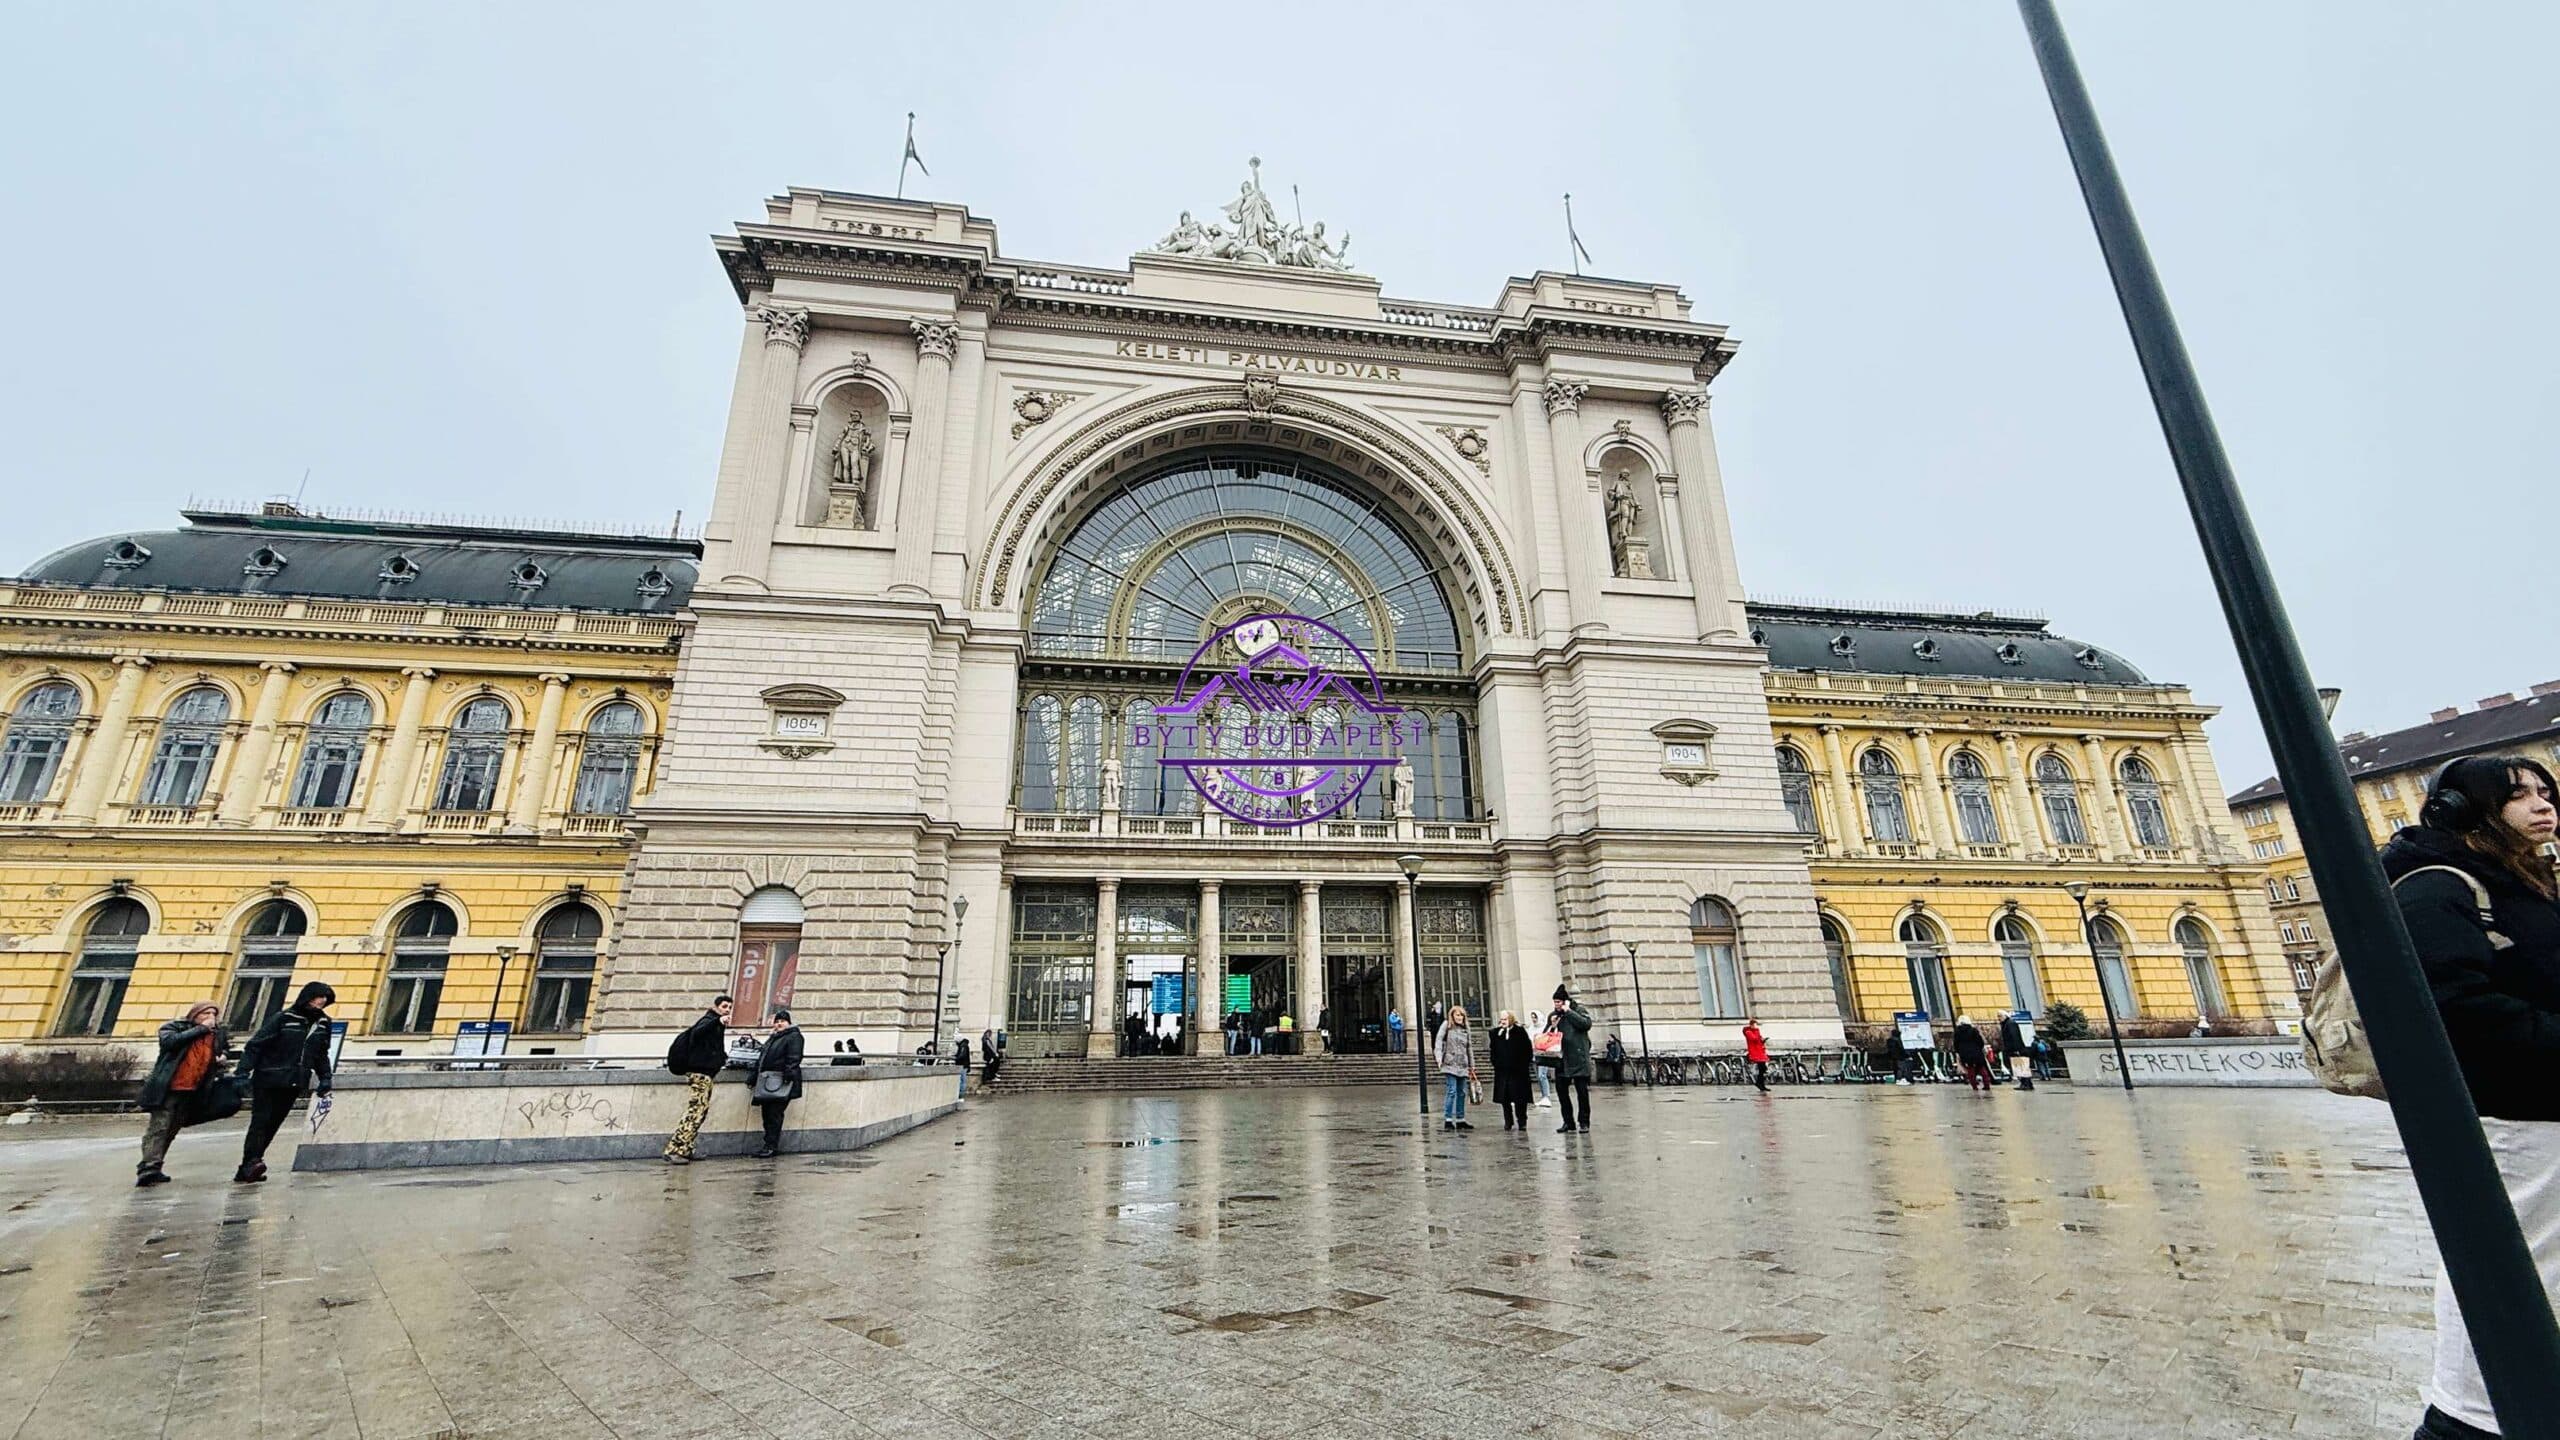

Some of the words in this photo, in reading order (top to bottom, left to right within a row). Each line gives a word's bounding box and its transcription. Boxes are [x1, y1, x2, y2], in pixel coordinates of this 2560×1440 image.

[1116, 340, 1208, 363] KELETI
[785, 717, 818, 729] 1884
[1671, 747, 1697, 759] 1904
